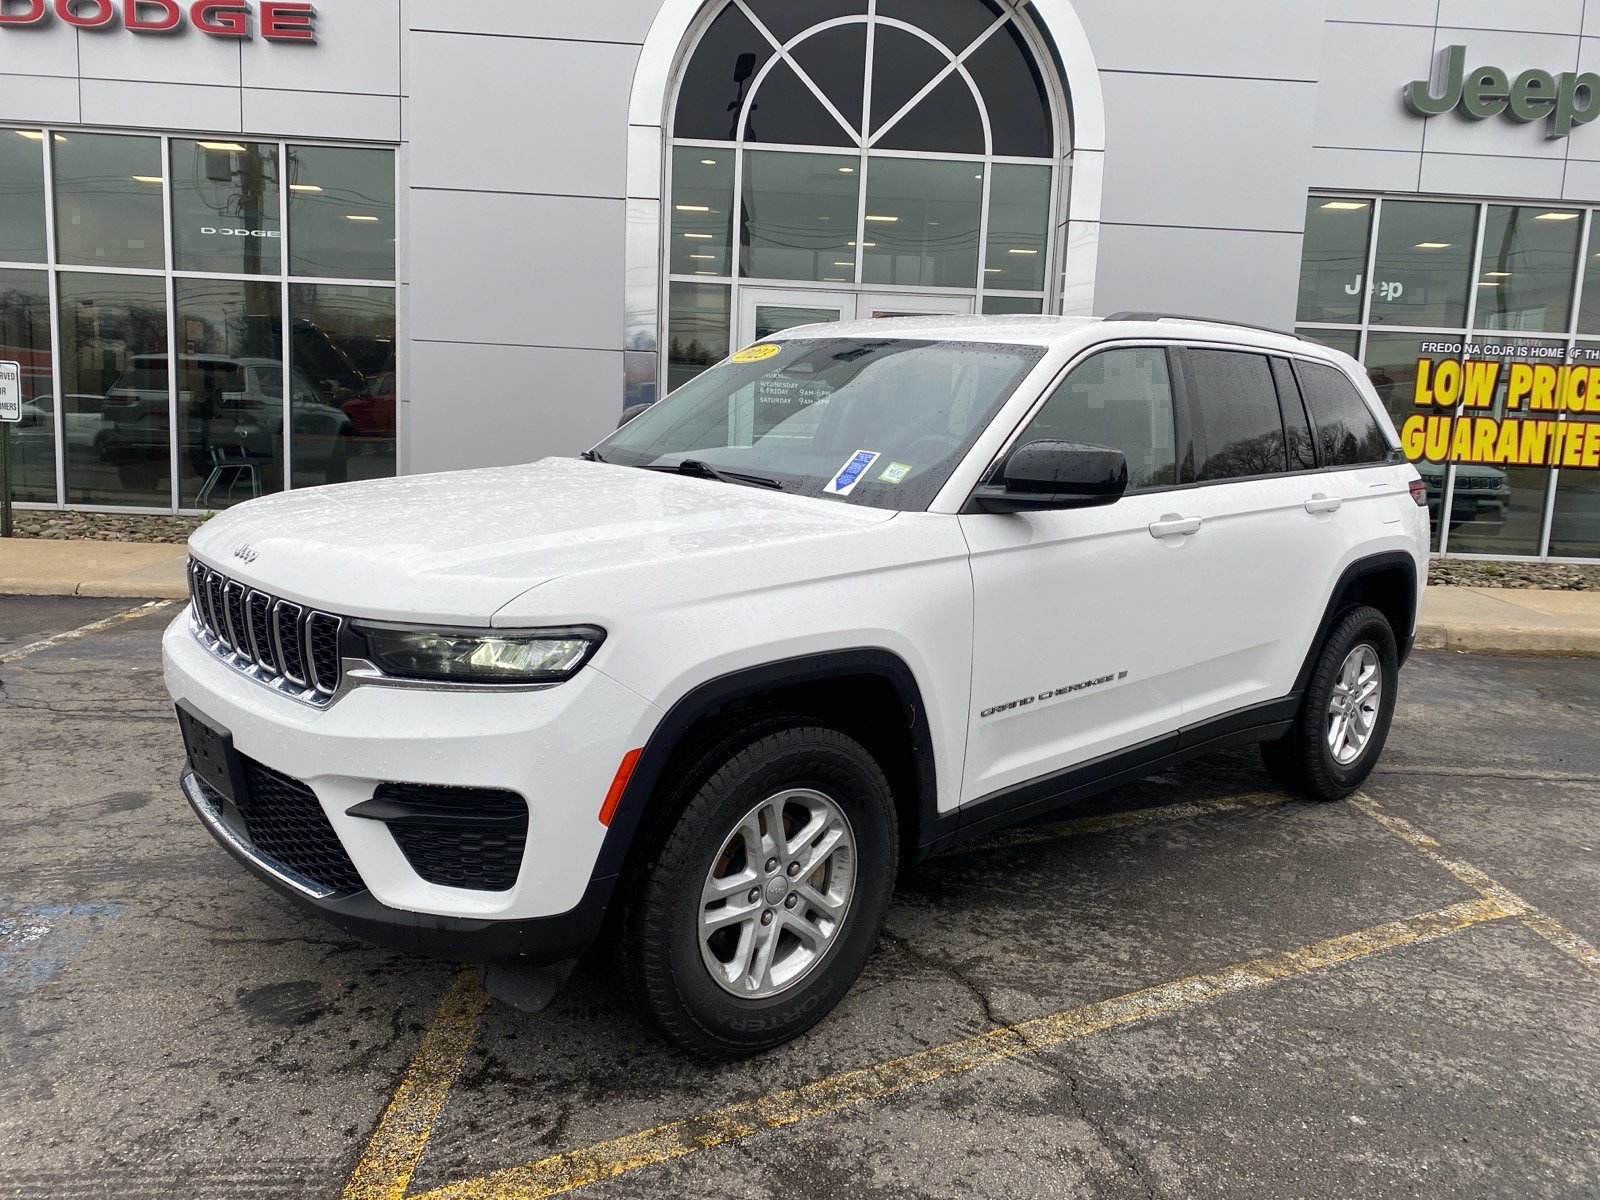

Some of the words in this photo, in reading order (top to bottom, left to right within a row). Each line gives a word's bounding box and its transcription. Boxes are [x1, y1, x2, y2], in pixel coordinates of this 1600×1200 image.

[0, 0, 317, 44] DODGE
[1404, 44, 1600, 140] Jeep
[200, 227, 280, 238] DODGE
[1483, 345, 1514, 356] CDJR
[1517, 346, 1528, 357] IS
[1531, 347, 1564, 358] HOME
[1414, 359, 1499, 408] LOW
[1507, 362, 1600, 413] PRICE
[1401, 414, 1600, 467] GUARANTEE
[980, 696, 1035, 718] GRAND
[1038, 673, 1116, 701] CHEROKEE
